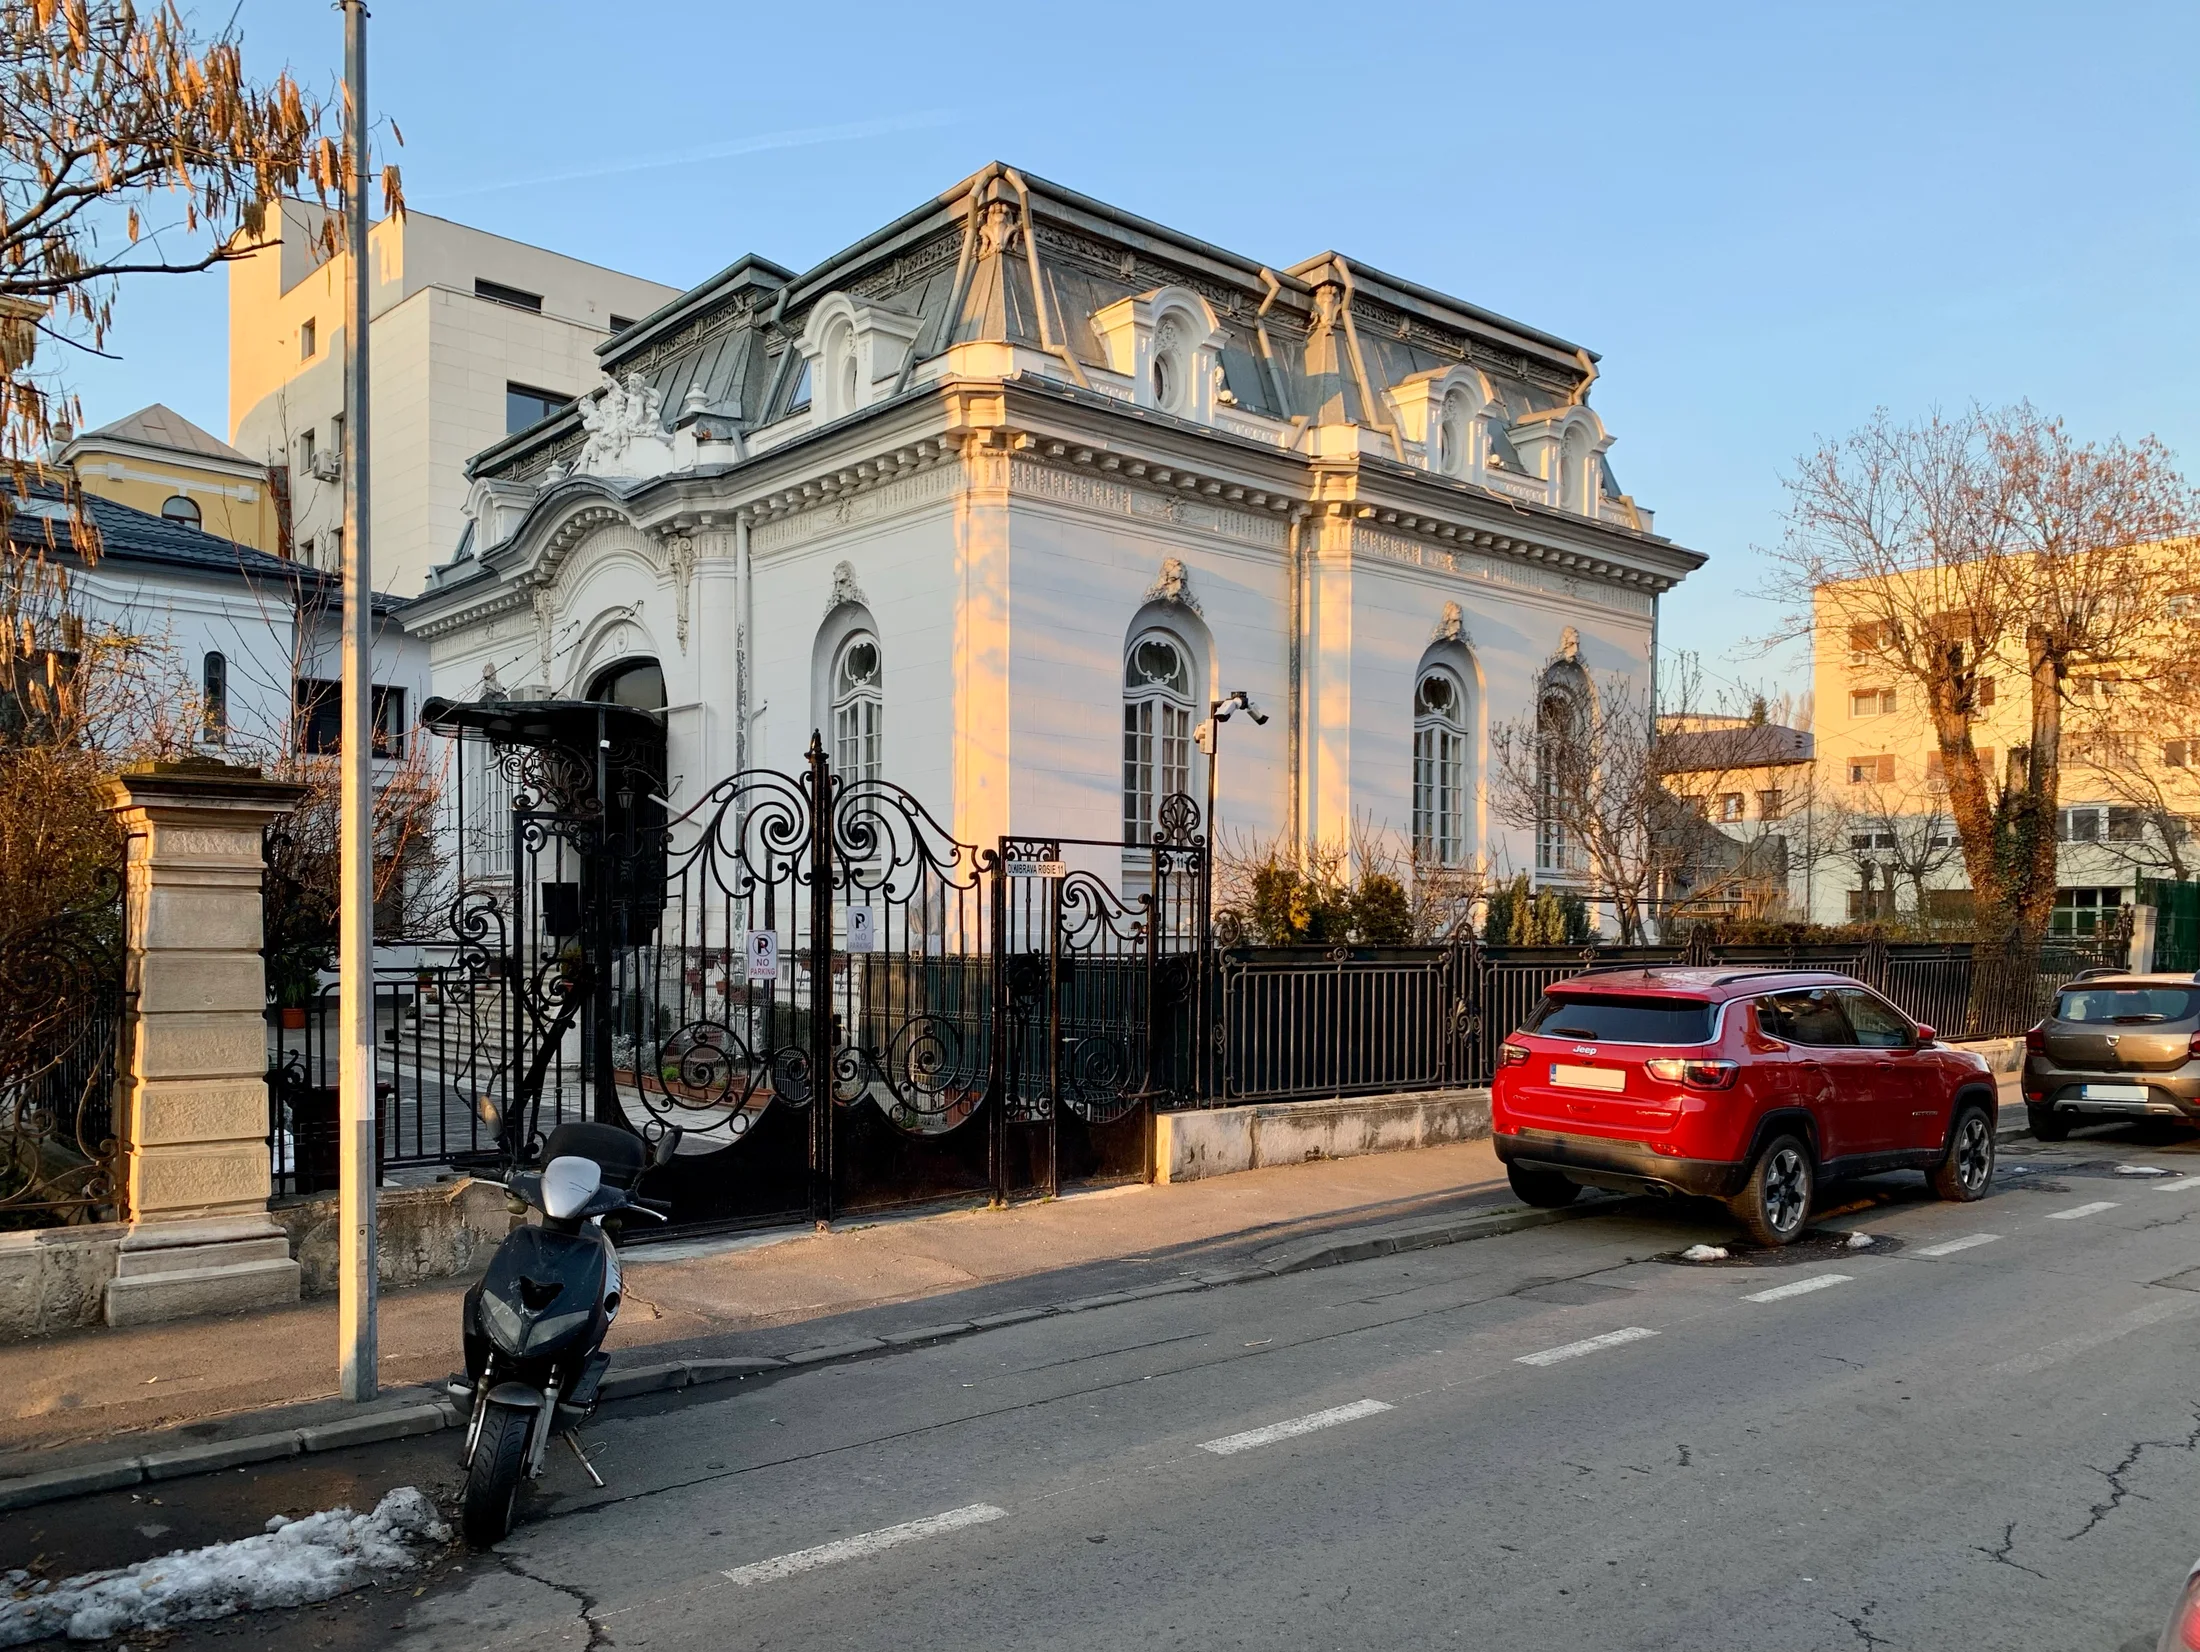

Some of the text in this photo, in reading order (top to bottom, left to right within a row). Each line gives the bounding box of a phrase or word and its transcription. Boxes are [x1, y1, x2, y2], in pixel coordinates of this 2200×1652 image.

[1176, 857, 1183, 868] 11
[1008, 864, 1064, 874] DUMBRAVA ROSIE 11
[854, 933, 867, 941] NO
[849, 941, 871, 949] PARKING
[756, 958, 770, 967] NO
[750, 967, 776, 976] PARKING
[1572, 1045, 1597, 1056] Jeep
